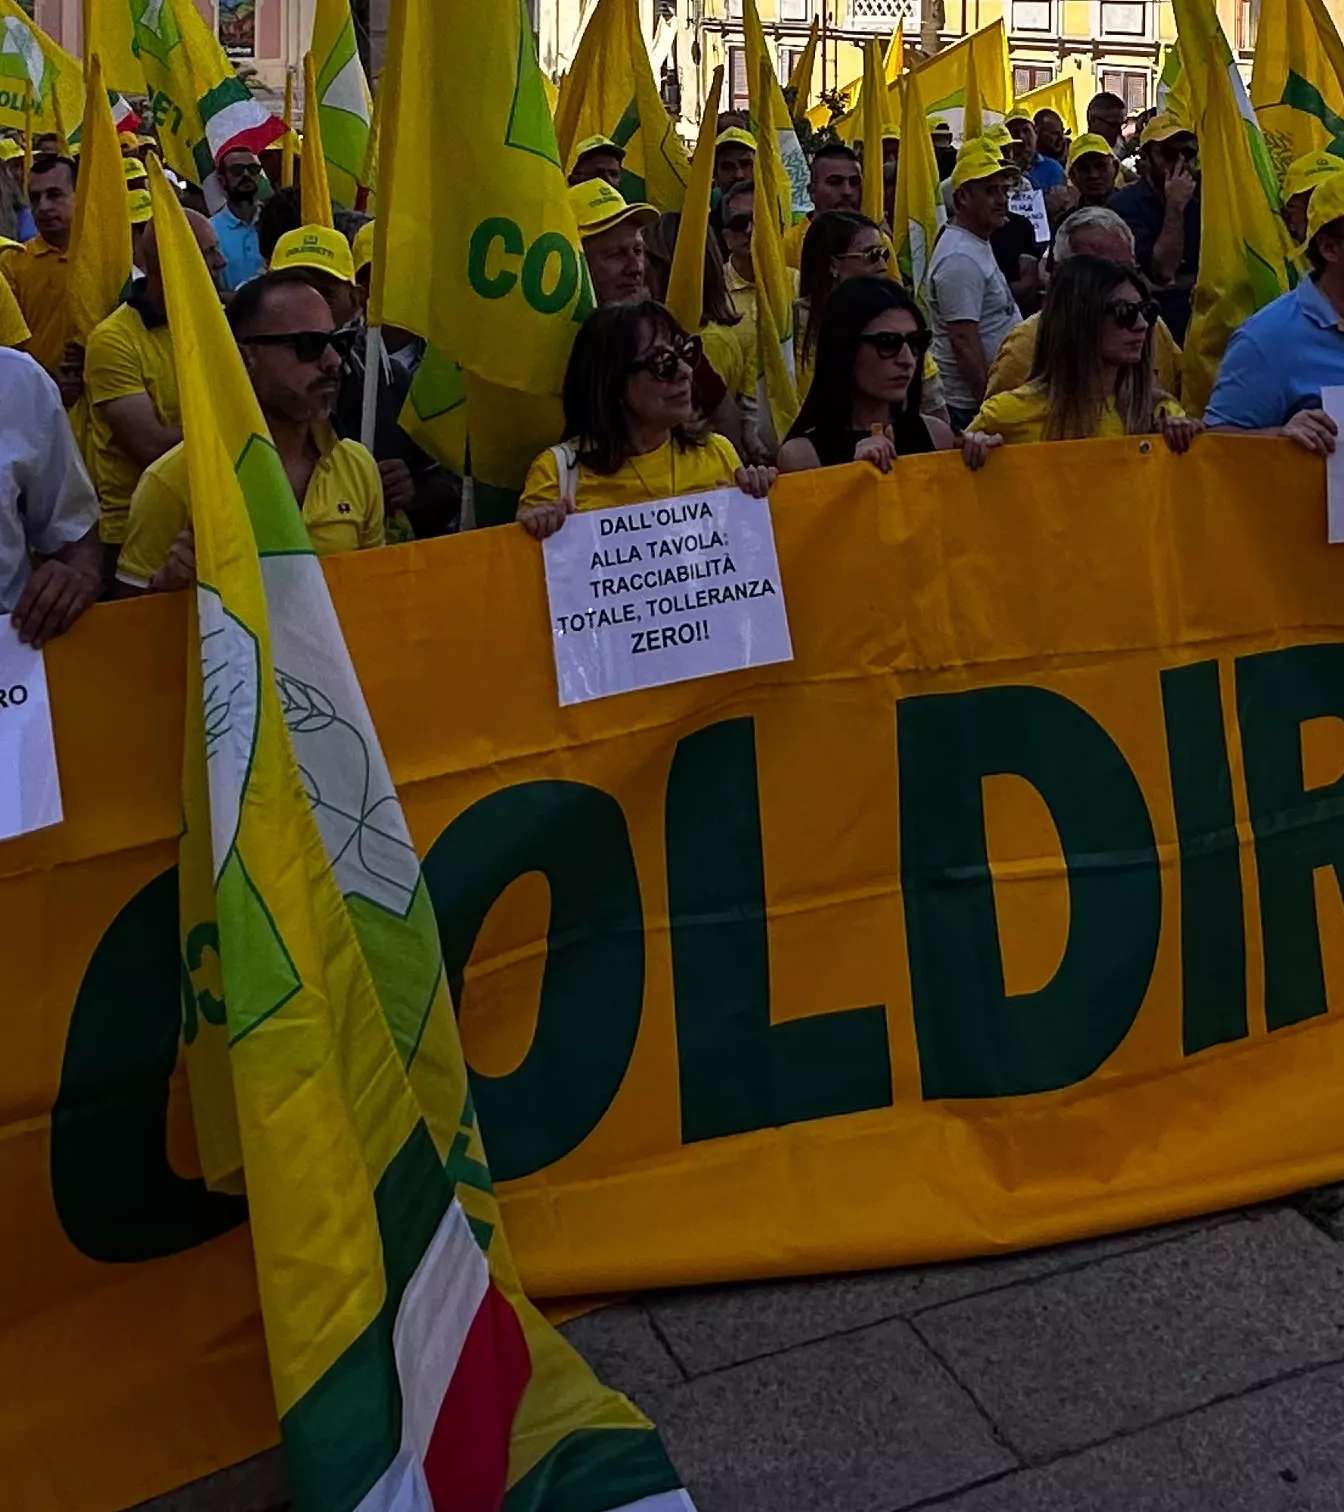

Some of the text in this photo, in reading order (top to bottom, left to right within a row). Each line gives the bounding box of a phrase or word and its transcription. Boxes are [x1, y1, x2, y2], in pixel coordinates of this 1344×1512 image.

[600, 502, 713, 536] DALL'OLIVA
[590, 531, 729, 569] ALLA TAVOLA:
[590, 553, 736, 598] TRACCIABILITÀ
[558, 579, 776, 635] TOTALE, TOLLERANZA
[631, 620, 709, 654] ZERO!!
